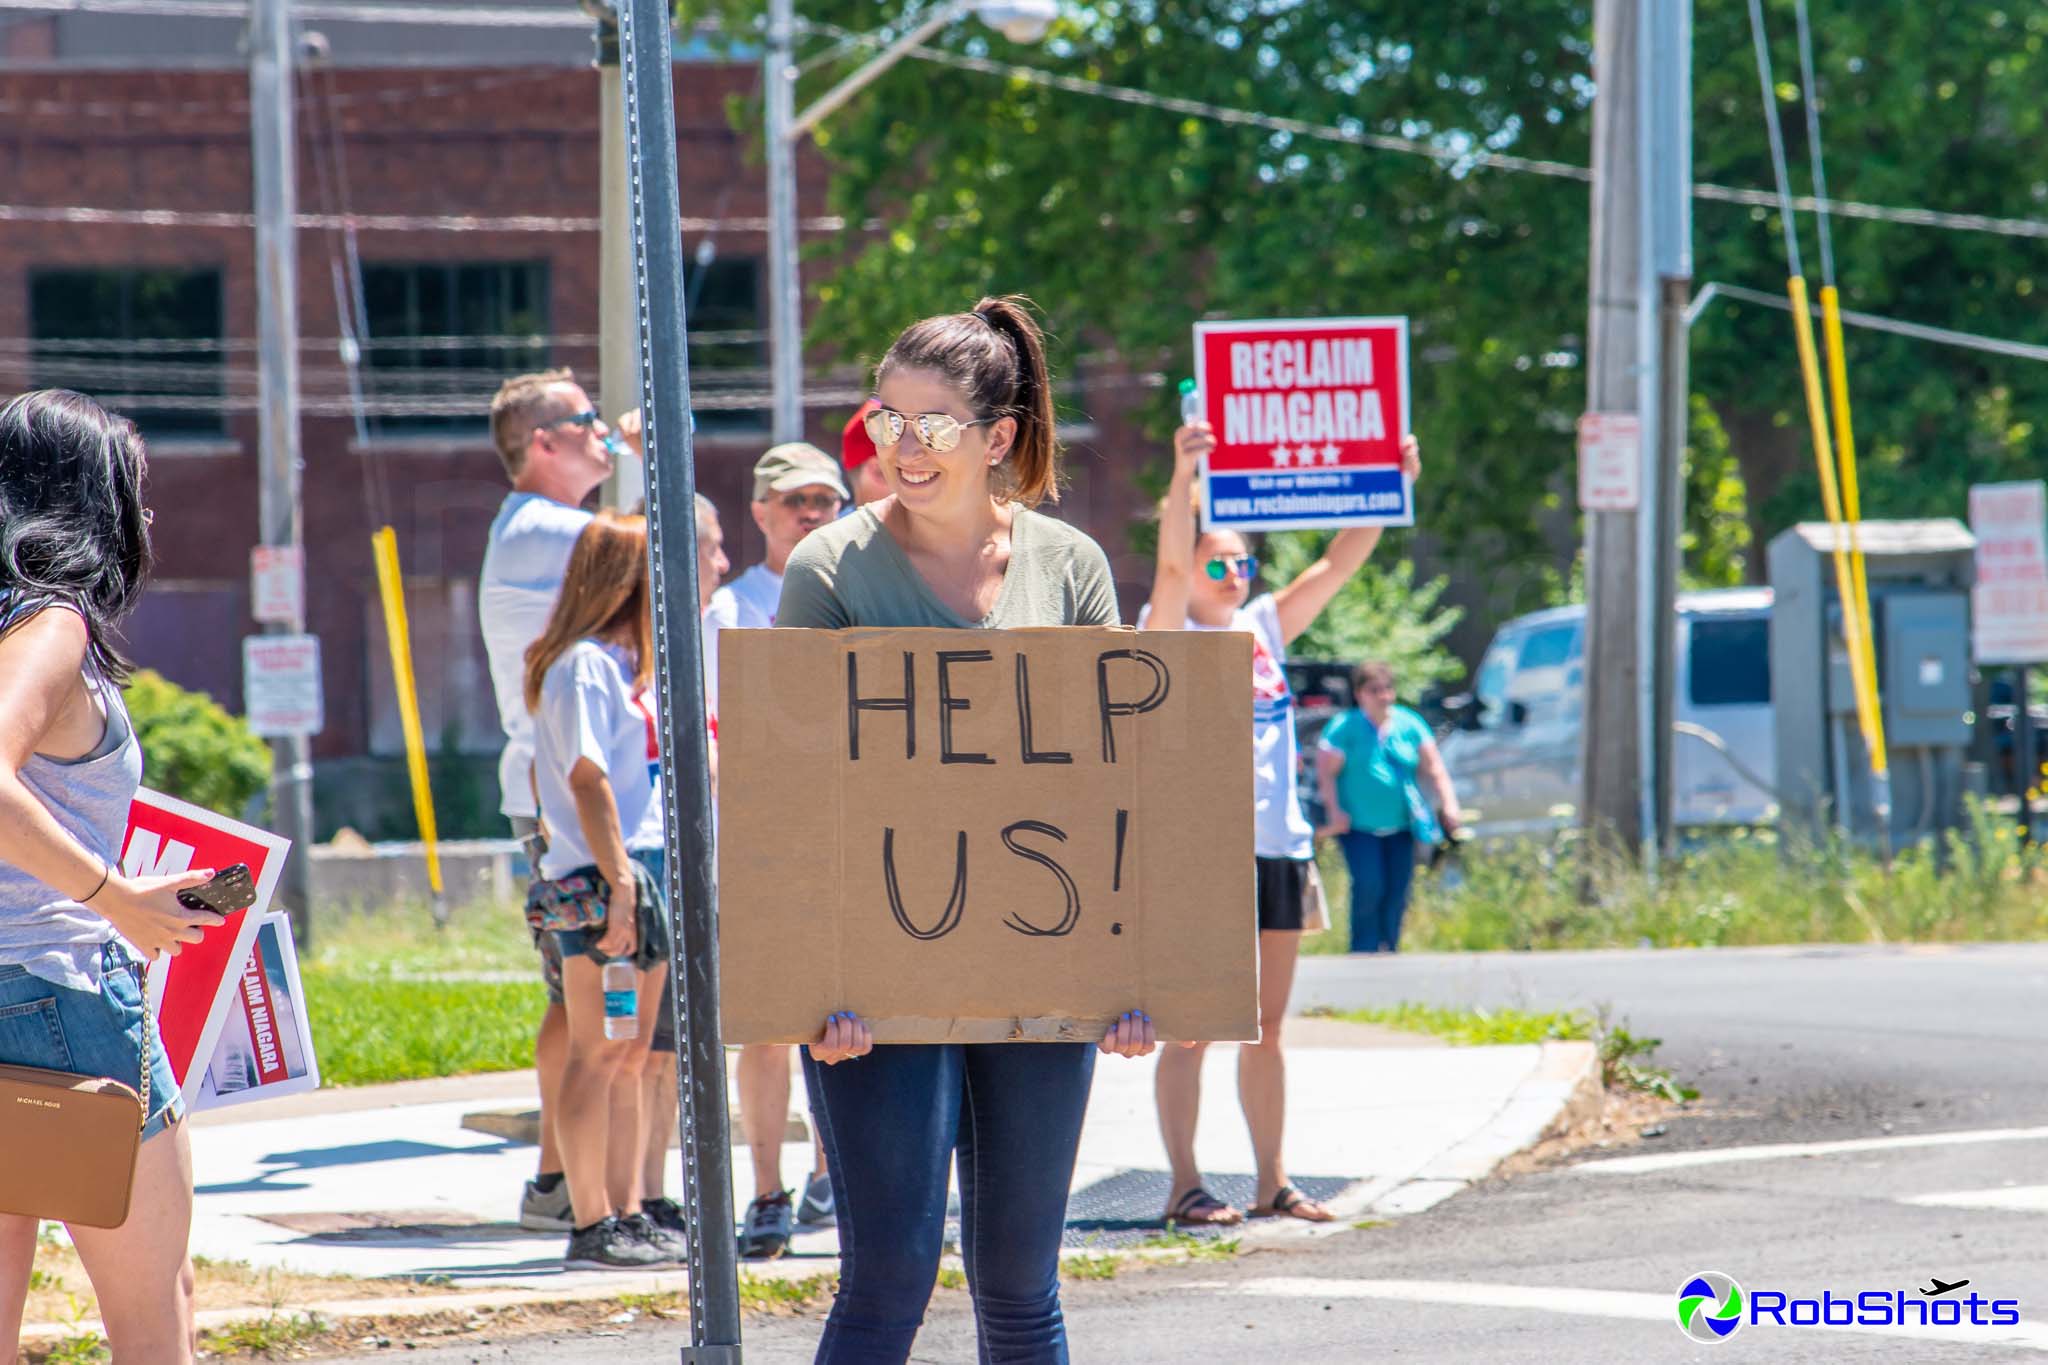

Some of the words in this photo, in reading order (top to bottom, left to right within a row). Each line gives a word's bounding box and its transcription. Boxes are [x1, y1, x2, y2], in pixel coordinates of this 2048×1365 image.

[1231, 338, 1374, 389] RECLAIM
[1223, 389, 1386, 445] NIAGARA
[847, 649, 1170, 764] HELP
[883, 808, 1128, 940] US!
[250, 1006, 280, 1074] NIAGARA
